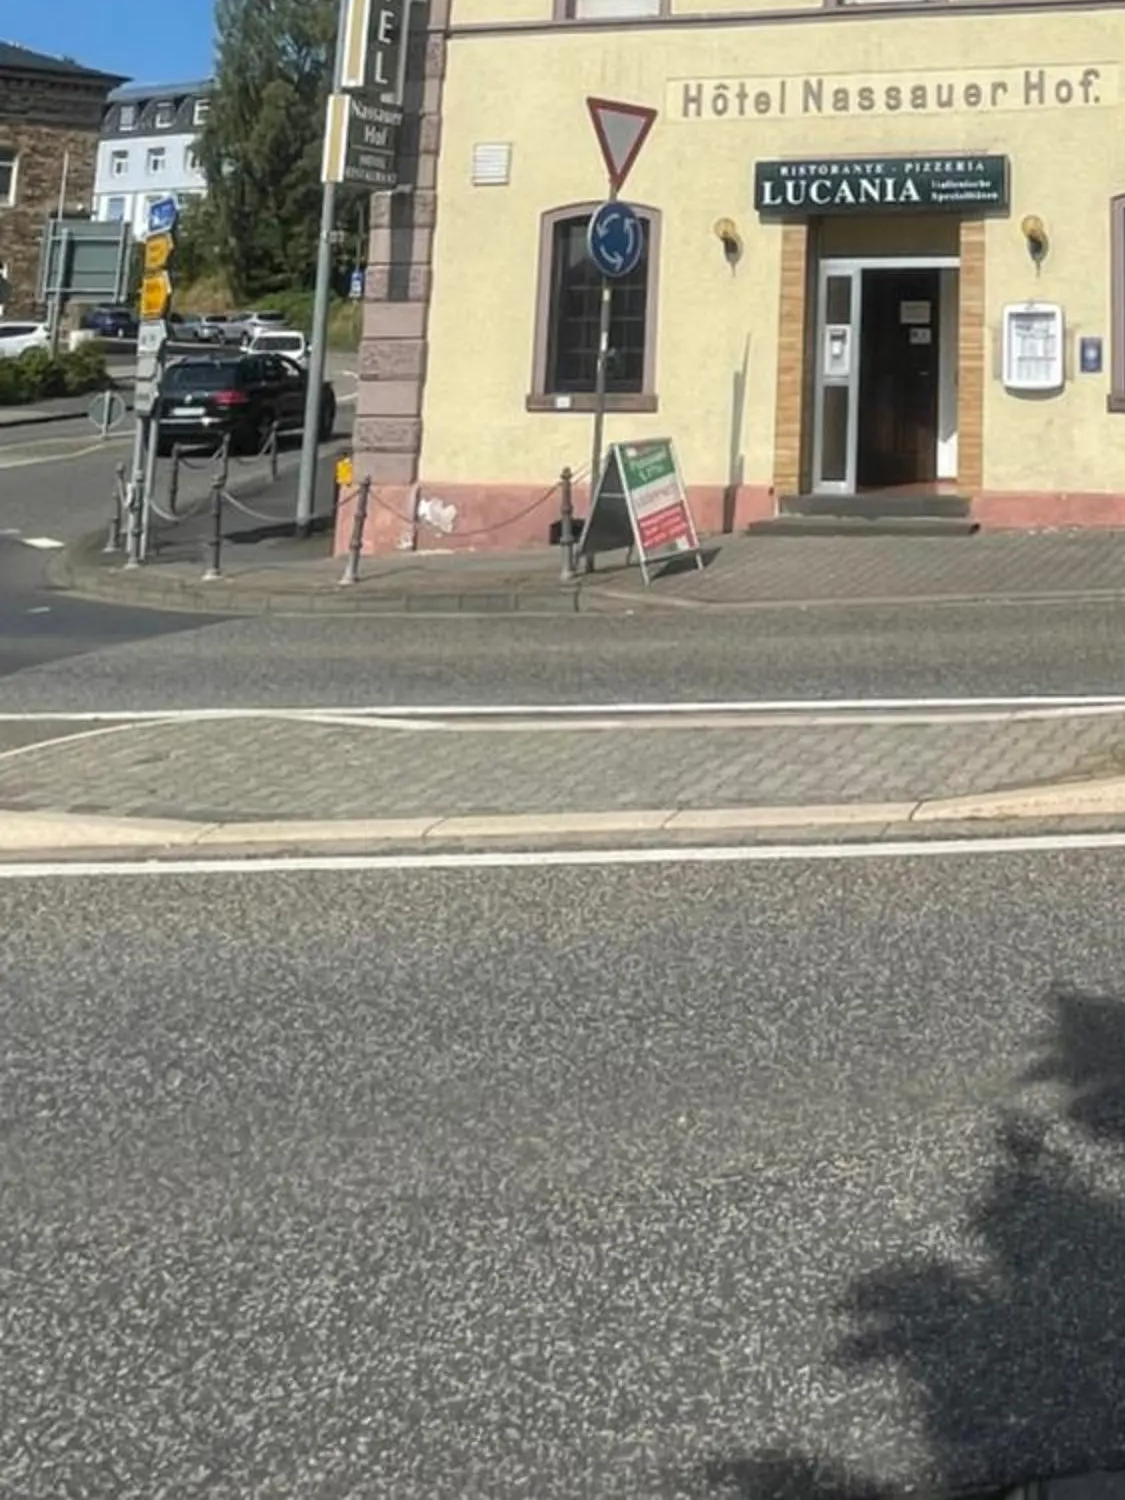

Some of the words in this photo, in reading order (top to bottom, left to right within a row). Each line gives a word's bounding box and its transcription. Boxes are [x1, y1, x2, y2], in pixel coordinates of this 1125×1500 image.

[681, 80, 786, 118] Hôtel
[802, 77, 1008, 114] Nassauer
[1023, 67, 1101, 106] Hof.
[363, 123, 389, 147] Hof
[779, 163, 884, 177] RISTORANTE
[904, 160, 985, 174] PIZZERIA
[761, 177, 922, 205] LUCANIA
